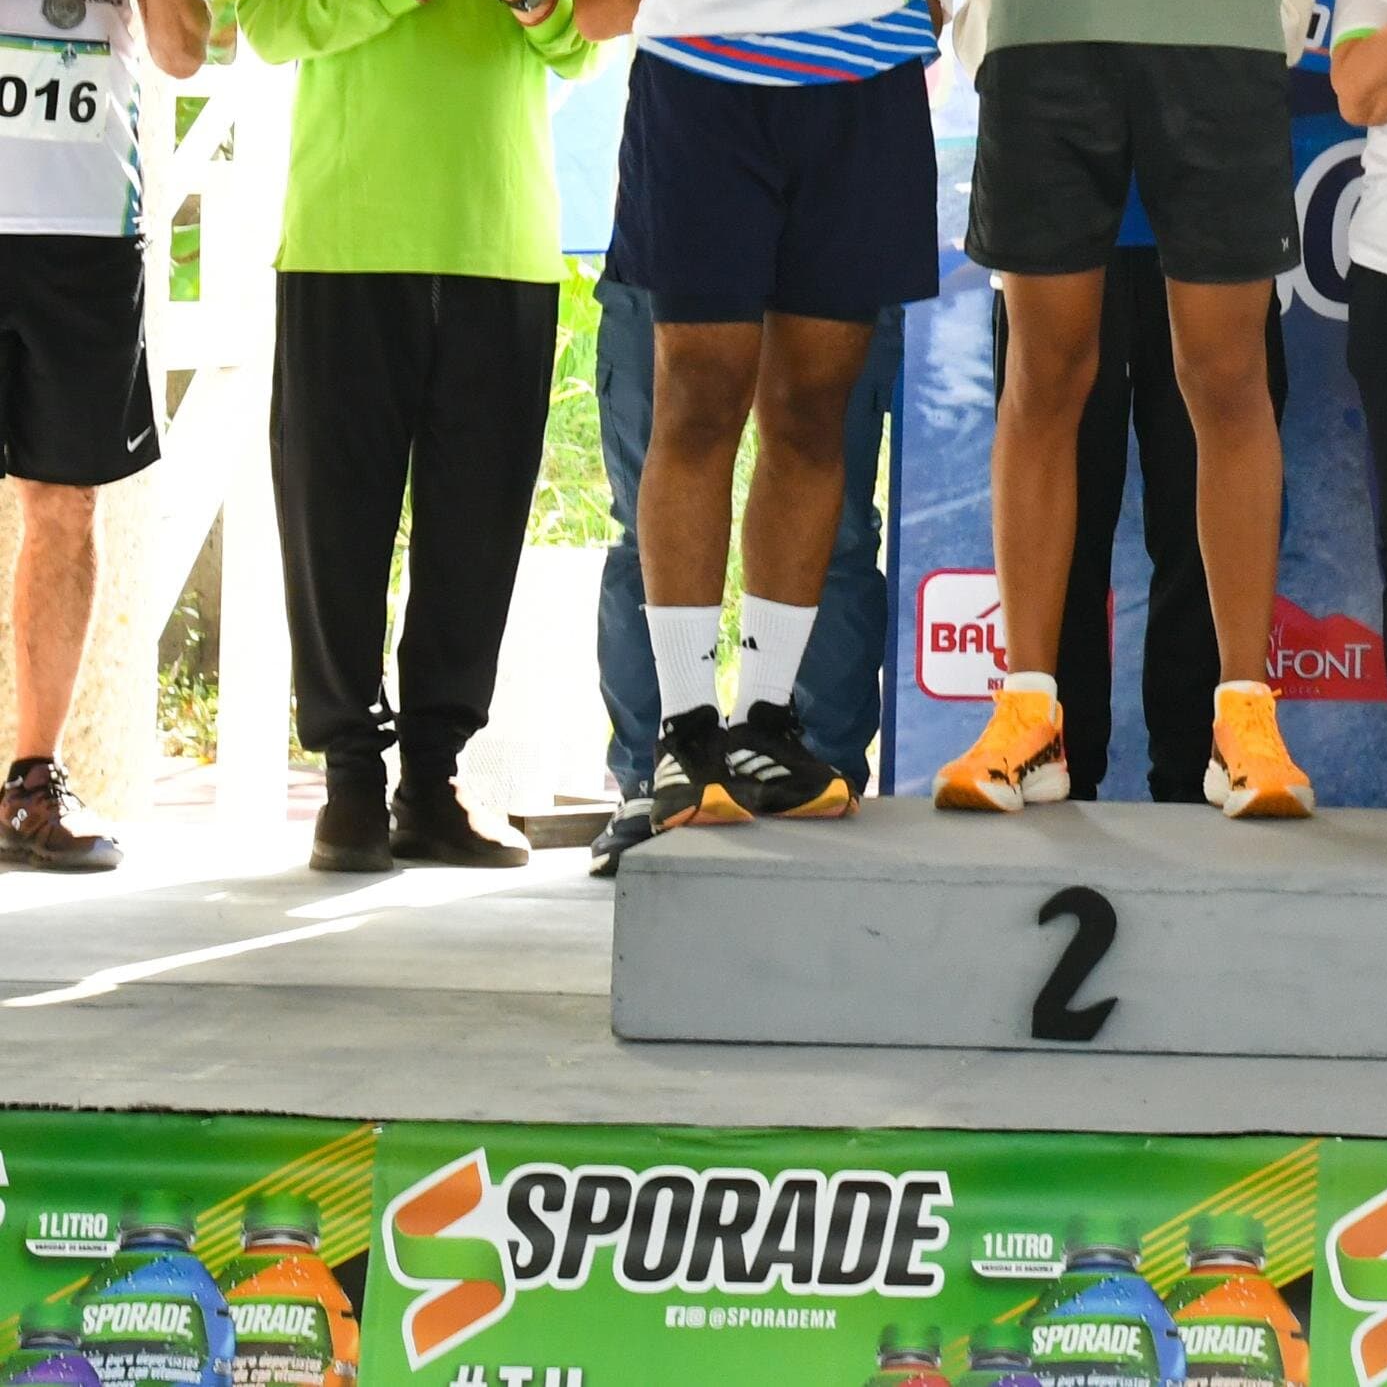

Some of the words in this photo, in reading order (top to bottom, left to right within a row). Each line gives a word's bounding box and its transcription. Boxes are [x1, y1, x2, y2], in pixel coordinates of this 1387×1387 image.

[0, 75, 98, 124] 016
[1030, 885, 1120, 1042] 2
[51, 1212, 109, 1239] LITRO
[507, 1171, 949, 1286] SPORADE
[994, 1233, 1053, 1260] LITRO
[82, 1303, 193, 1338] SPORADE
[708, 1304, 838, 1330] @SPORADEMX
[1032, 1325, 1142, 1358] SPORADE
